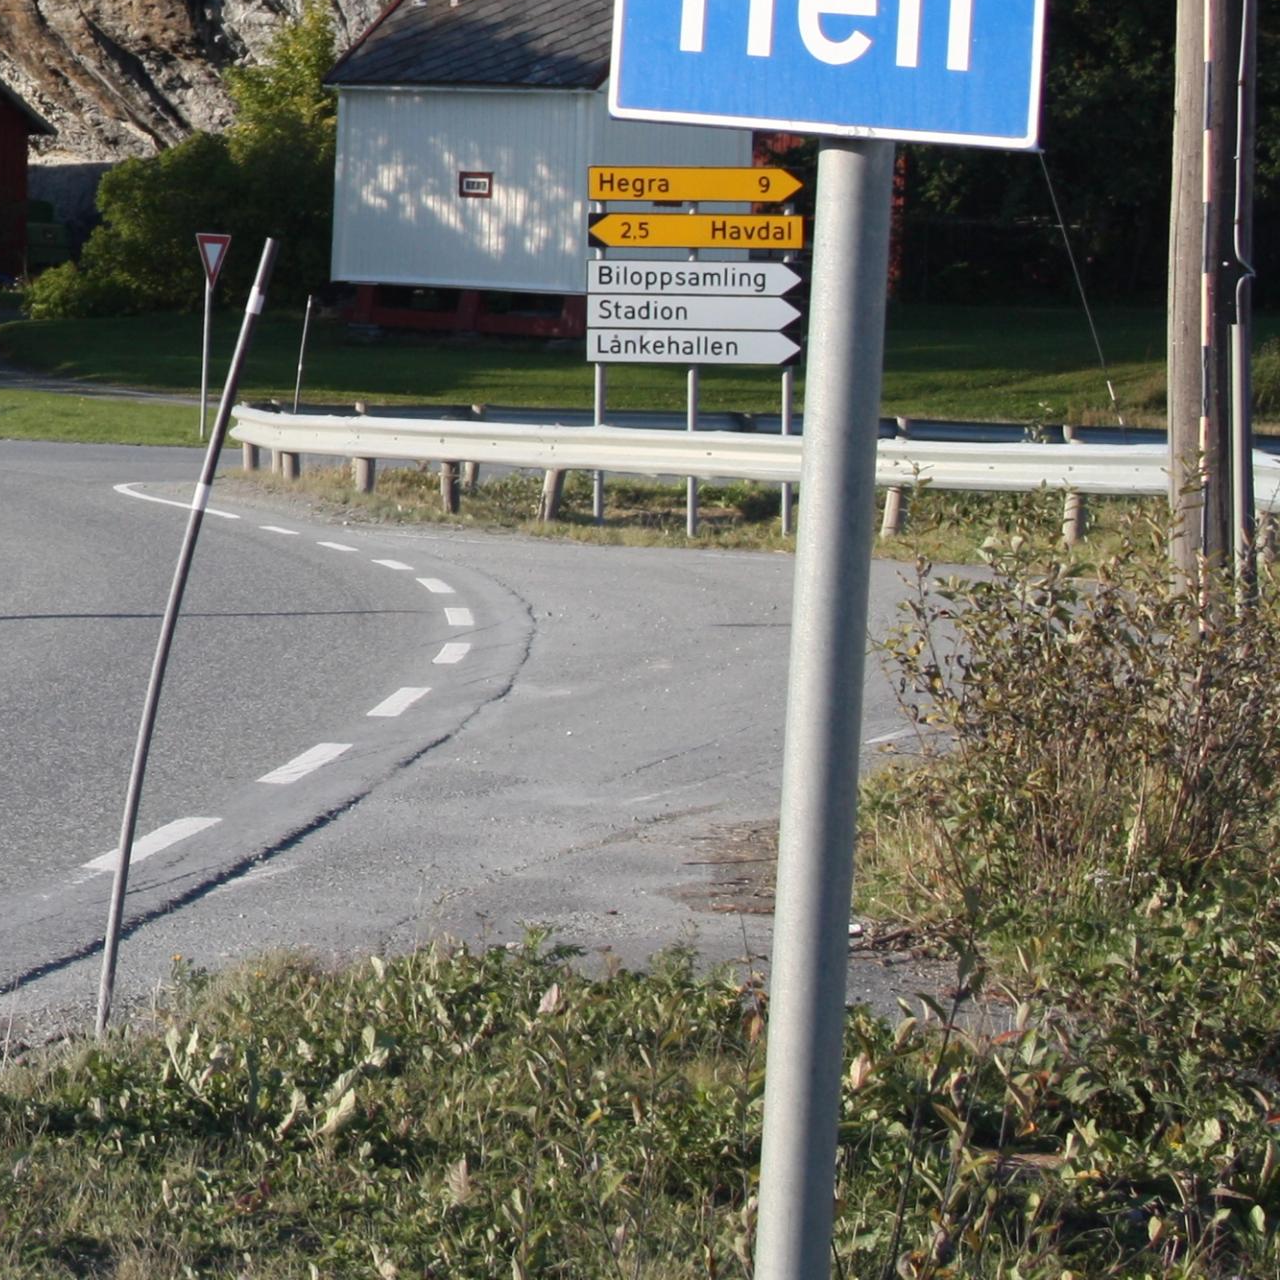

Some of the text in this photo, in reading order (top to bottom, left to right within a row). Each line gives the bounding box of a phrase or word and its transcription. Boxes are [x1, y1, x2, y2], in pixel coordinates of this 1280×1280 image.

[598, 173, 771, 197] Hegra 9
[711, 221, 792, 240] Havdal
[598, 266, 766, 292] Biloppsamling
[598, 300, 688, 320] Stadion
[597, 335, 738, 356] Lånkehallen
